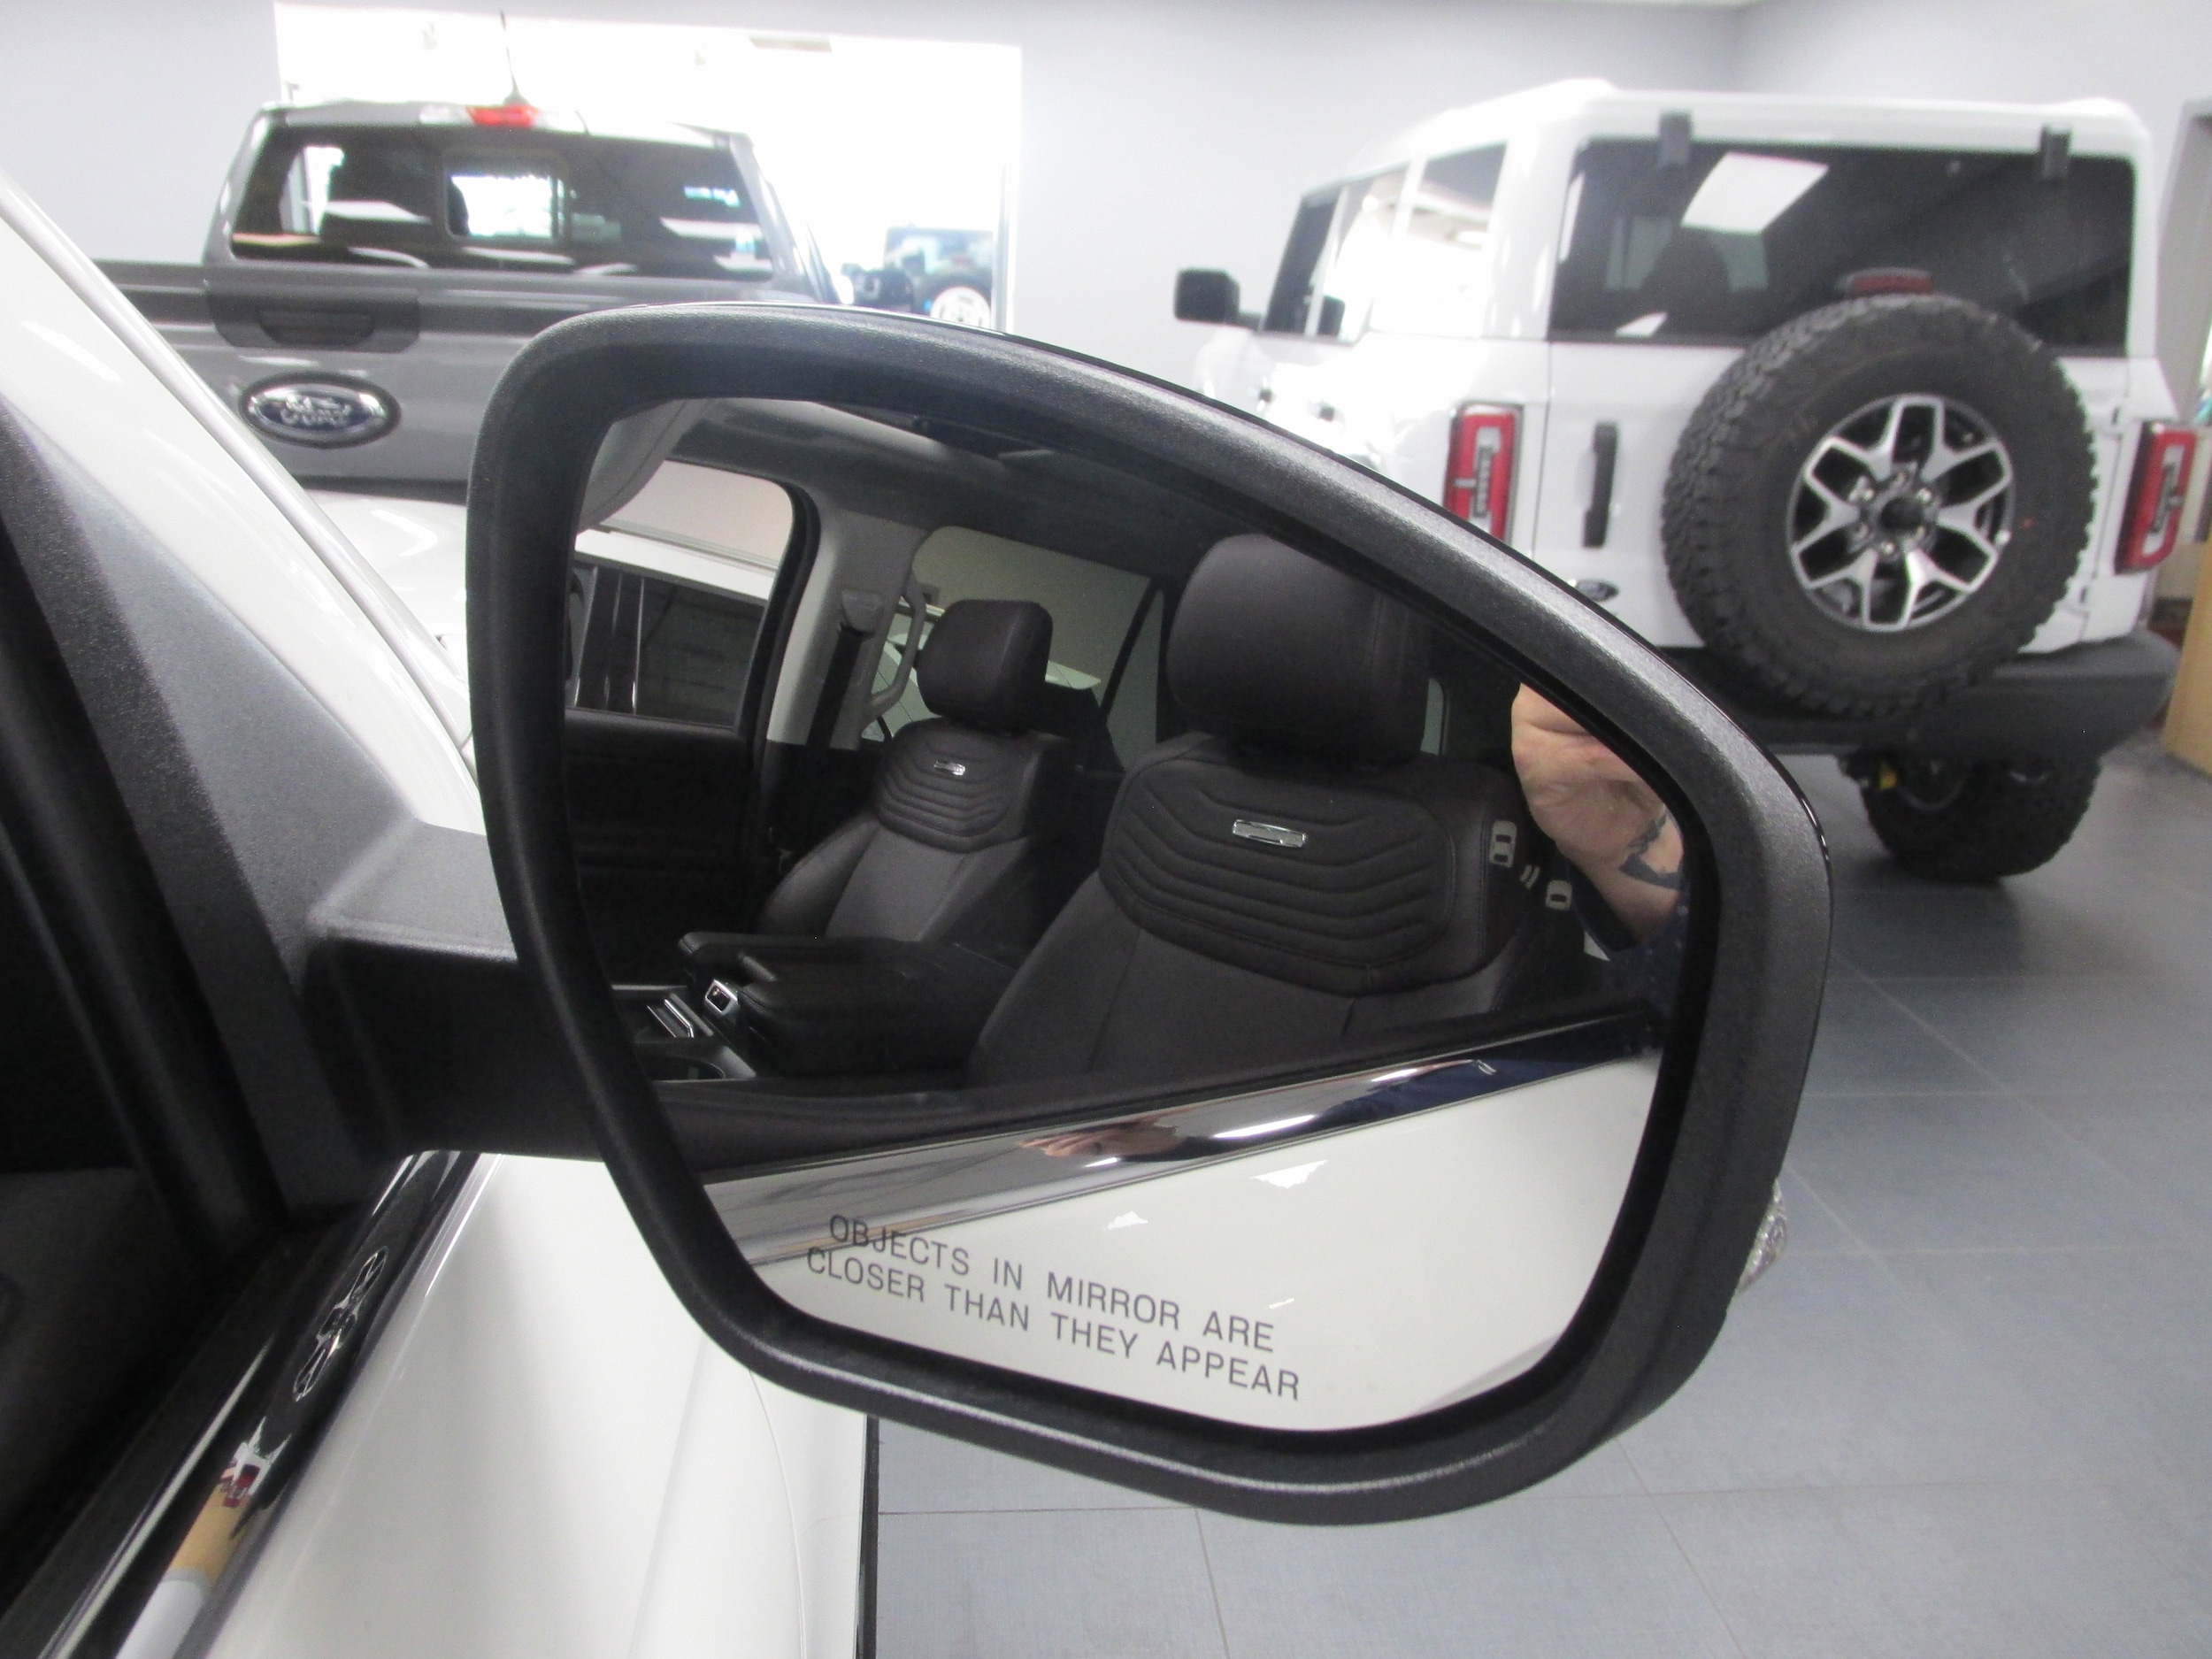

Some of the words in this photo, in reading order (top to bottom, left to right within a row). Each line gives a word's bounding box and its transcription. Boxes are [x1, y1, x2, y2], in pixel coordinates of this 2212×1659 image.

[806, 1246, 926, 1303] CLOSER
[943, 1283, 1029, 1333] THAN
[1050, 1310, 1139, 1359] THEY
[1156, 1340, 1301, 1402] APPEAR
[828, 1213, 971, 1277] OBJECTS
[992, 1257, 1023, 1291] IN
[1047, 1271, 1180, 1331] MIRROR
[1202, 1310, 1274, 1354] ARE
